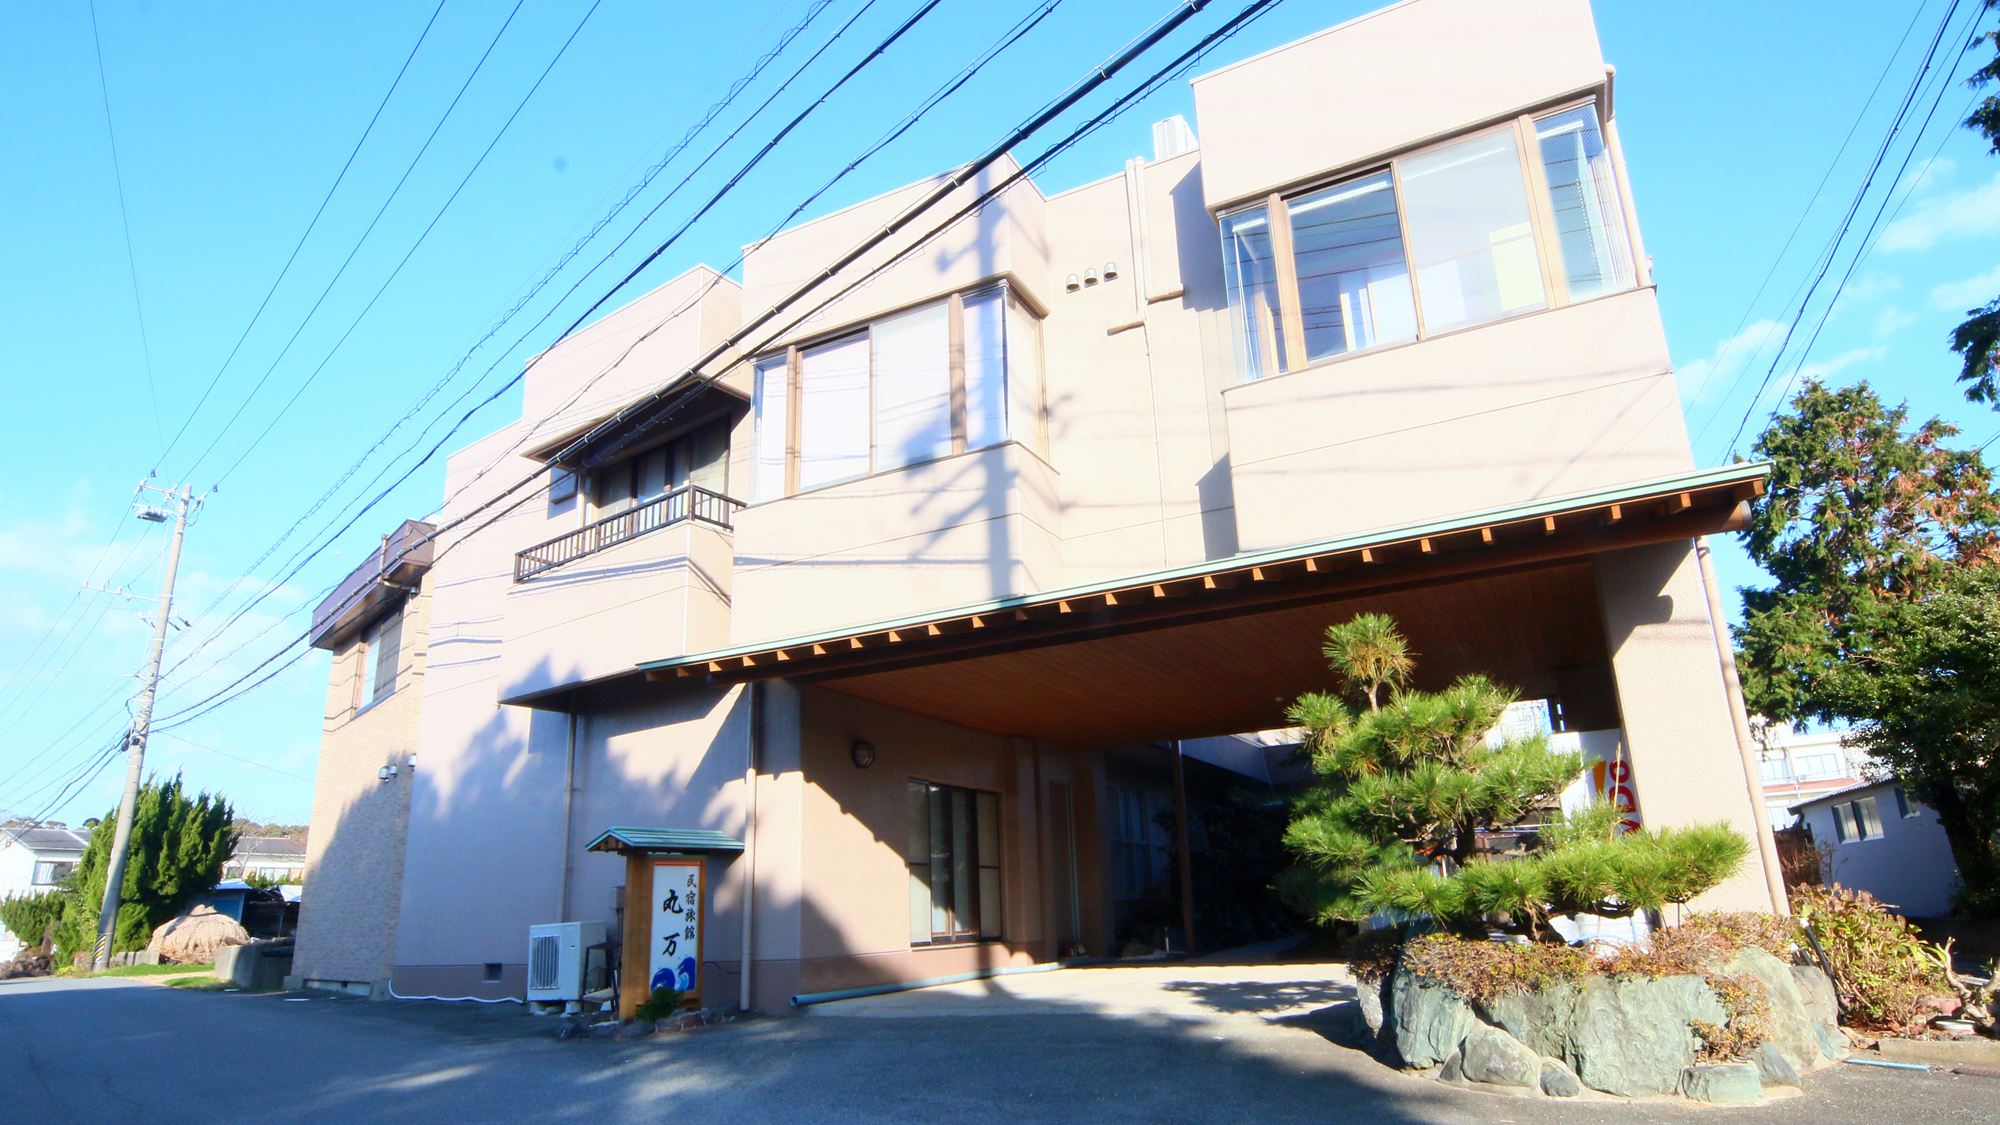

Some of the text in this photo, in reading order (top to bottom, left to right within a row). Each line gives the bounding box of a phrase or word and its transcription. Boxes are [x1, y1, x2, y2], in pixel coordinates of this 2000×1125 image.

[662, 889, 684, 957] 丸万
[684, 874, 697, 941] 民宿旅館
